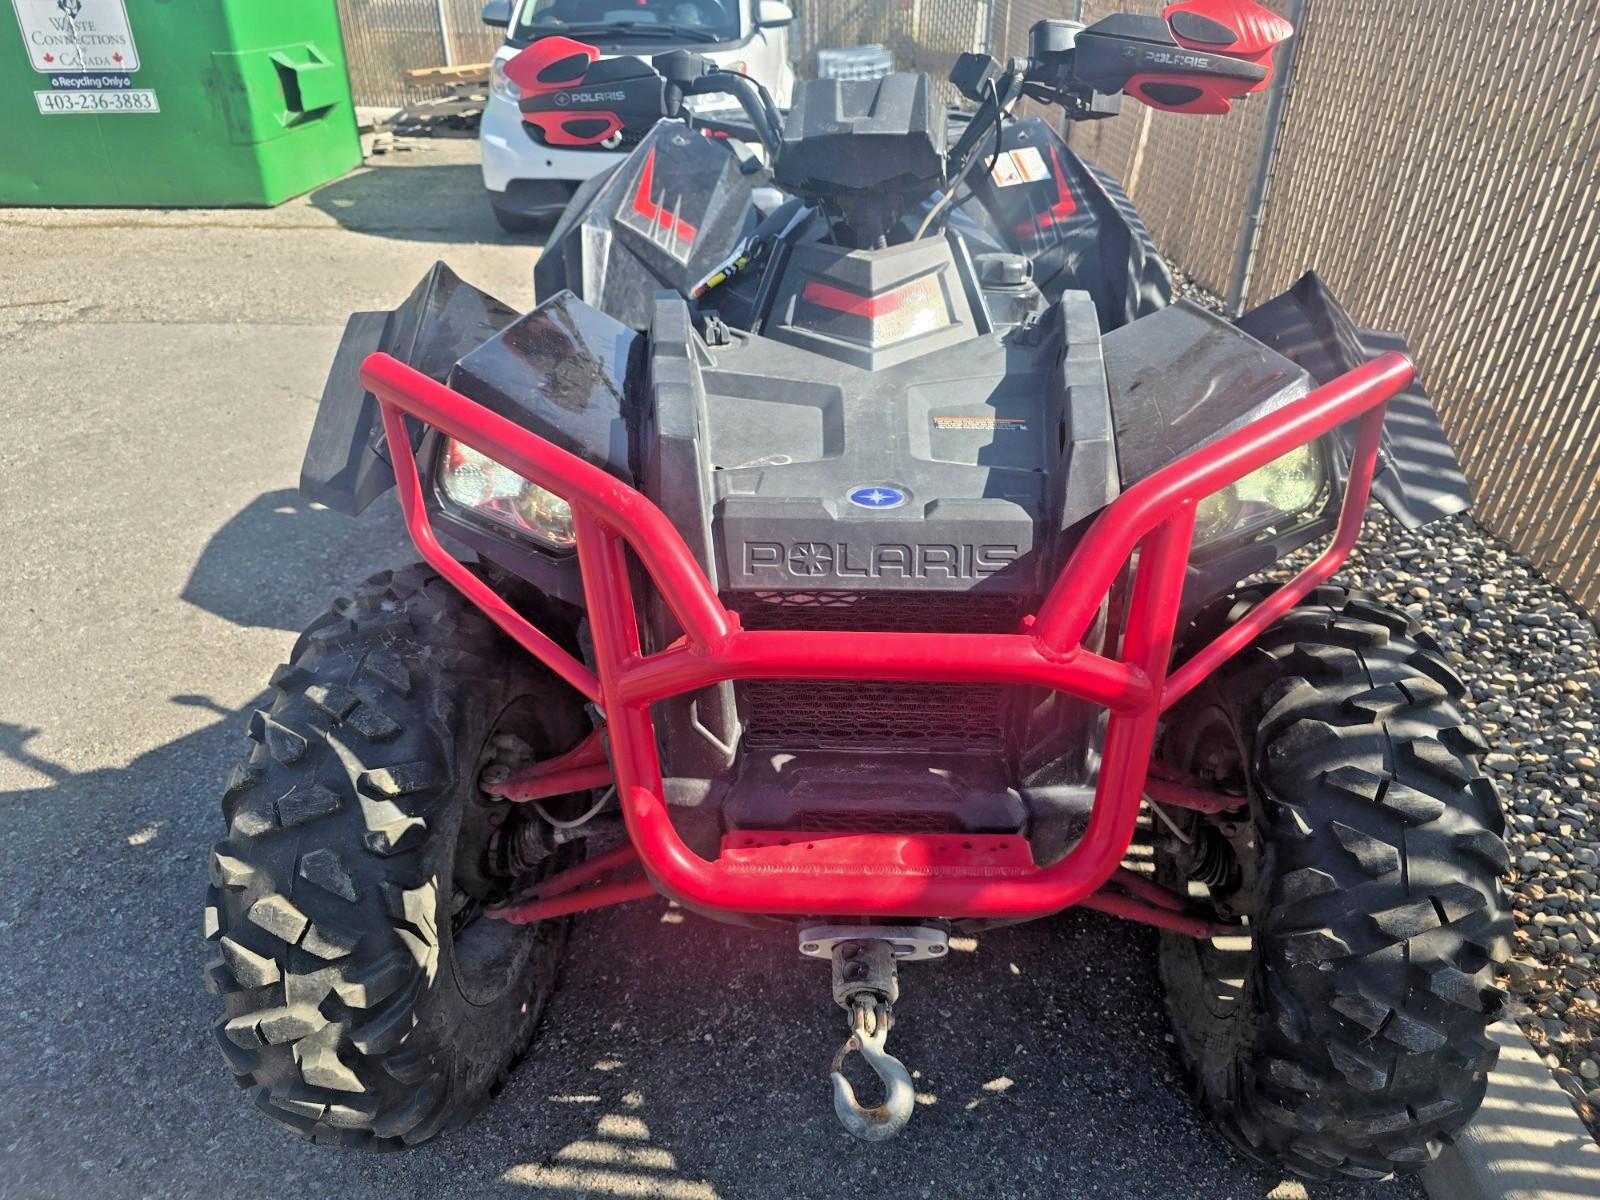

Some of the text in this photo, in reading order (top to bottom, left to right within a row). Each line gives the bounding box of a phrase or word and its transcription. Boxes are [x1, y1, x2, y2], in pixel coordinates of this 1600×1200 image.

[1144, 51, 1209, 69] POLARIS
[58, 76, 123, 88] Recycling Only
[44, 93, 152, 110] 403-236-3883
[571, 91, 626, 103] POLARIS
[743, 541, 1018, 579] POLARIS
